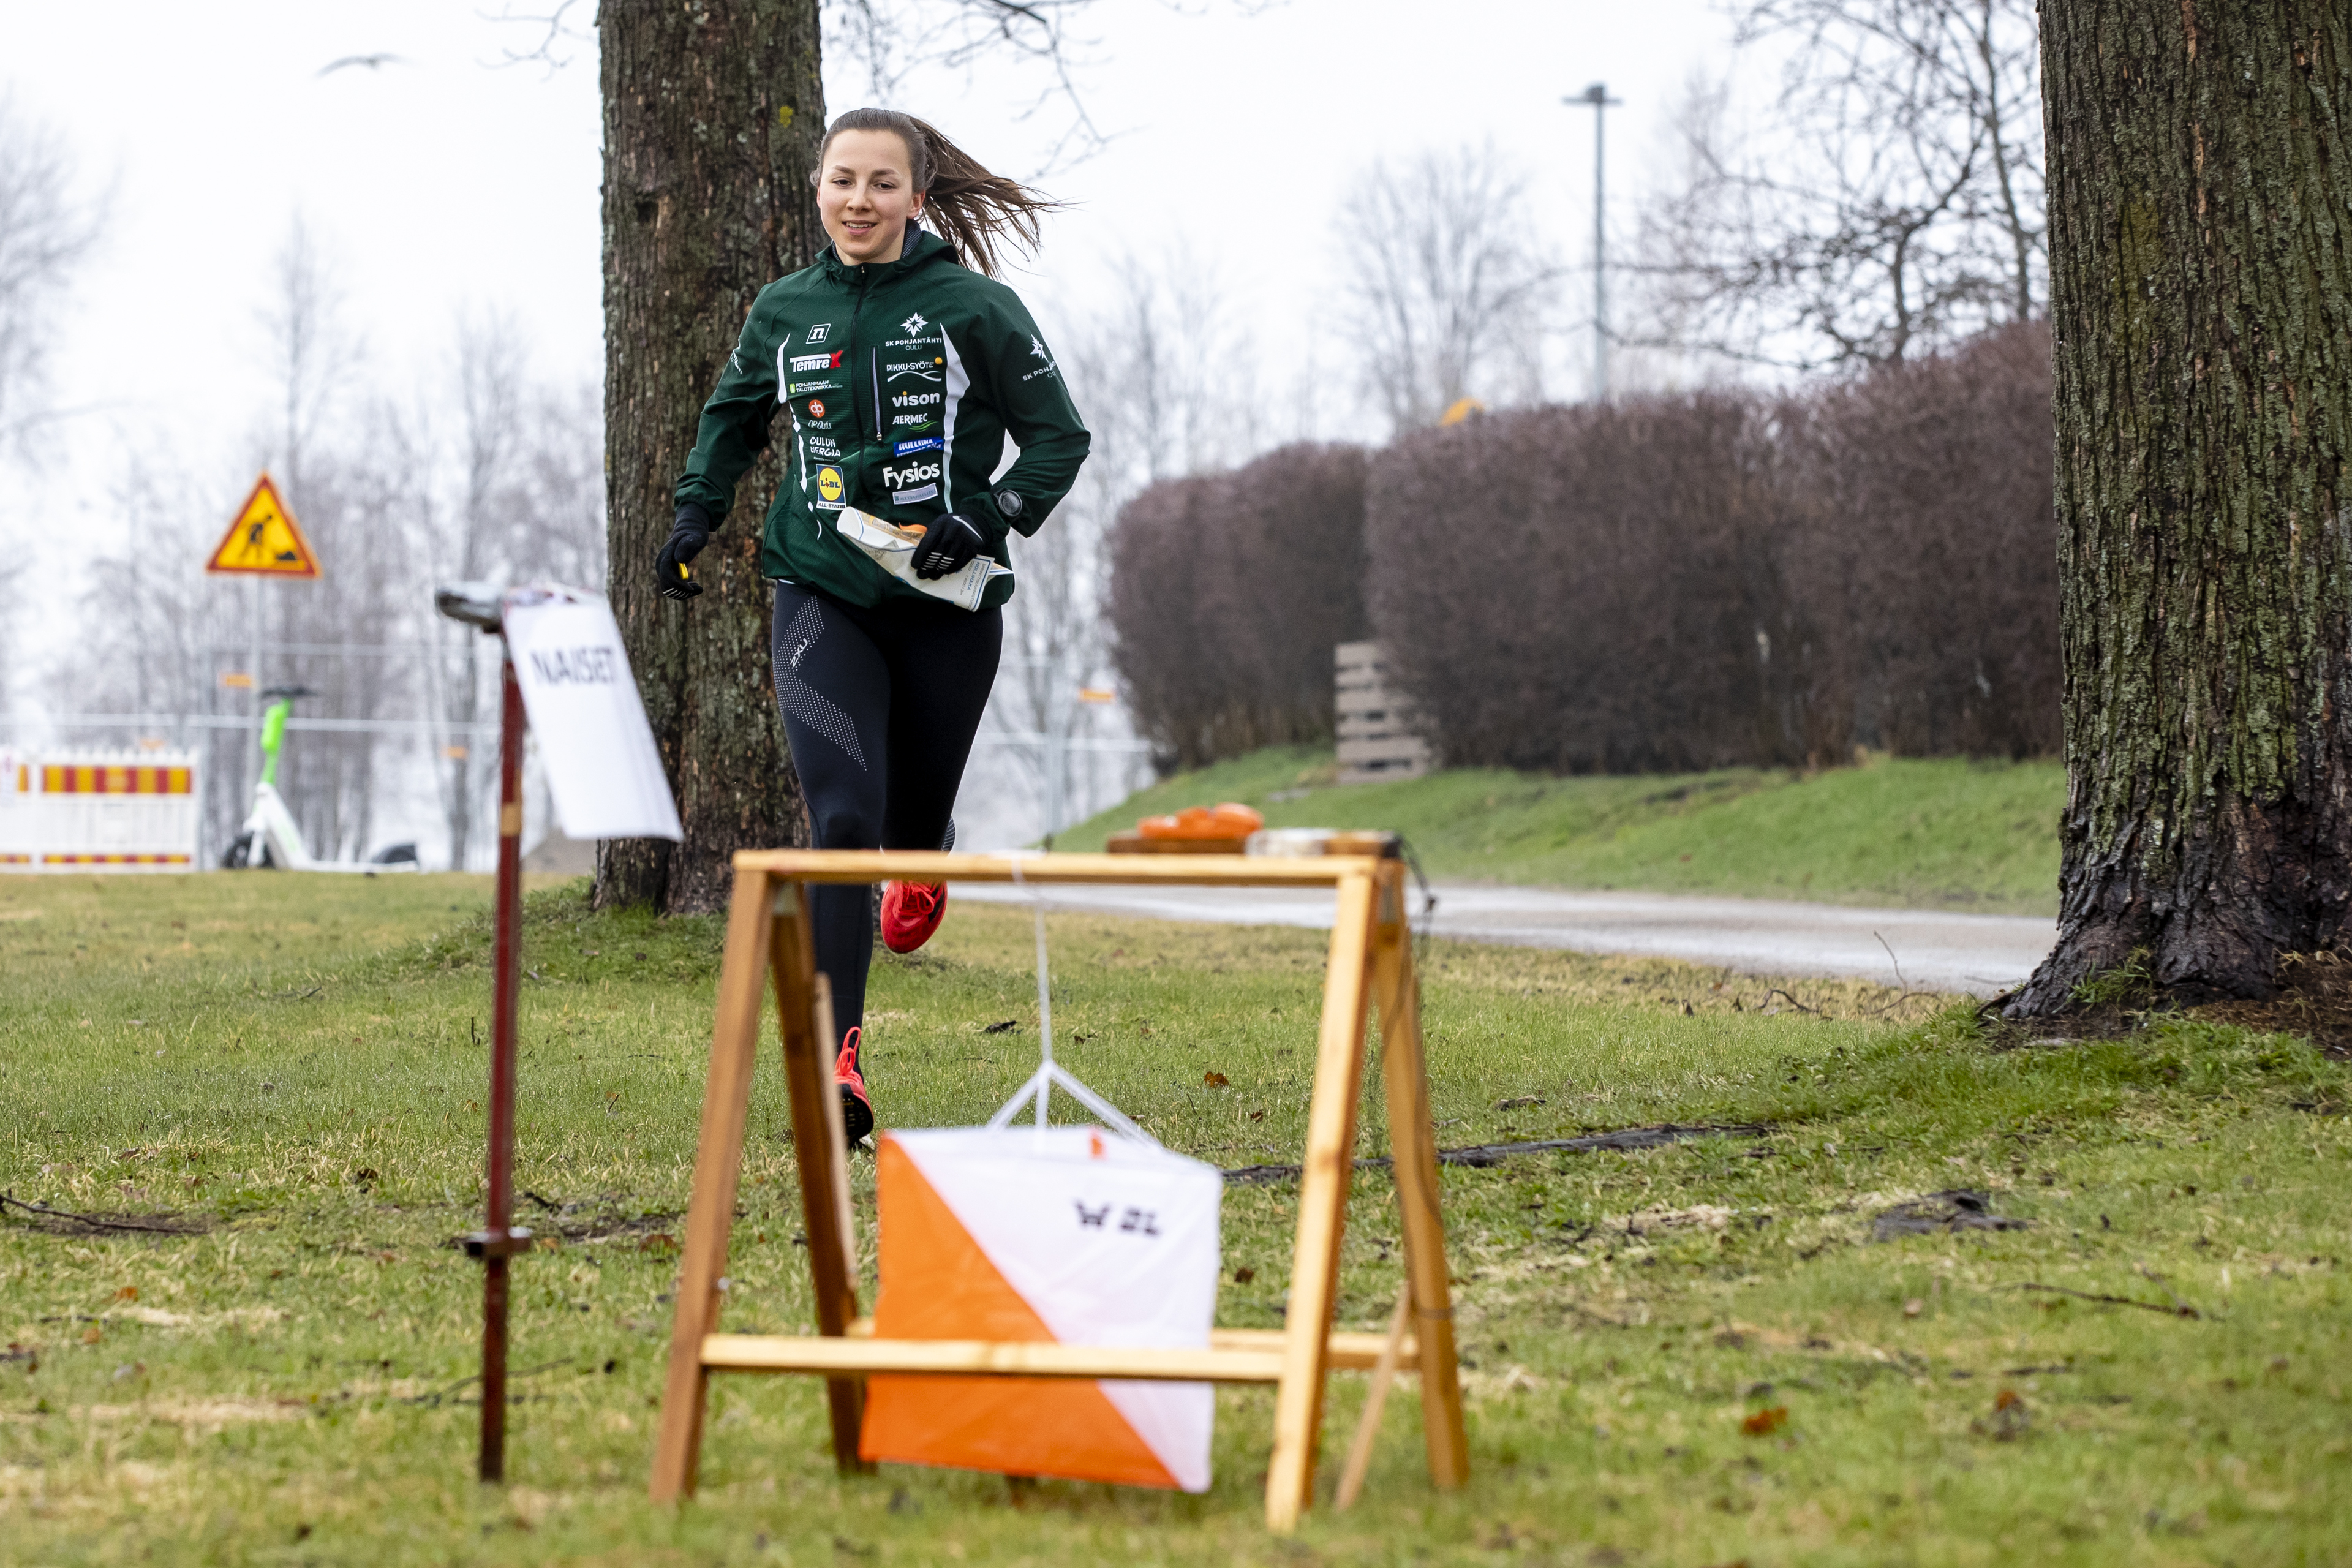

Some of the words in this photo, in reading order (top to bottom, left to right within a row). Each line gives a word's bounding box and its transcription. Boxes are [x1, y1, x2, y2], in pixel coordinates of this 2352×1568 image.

[895, 336, 942, 345] POHJANTÄHTI
[892, 391, 940, 407] vison
[892, 413, 928, 426] AERMEC
[809, 436, 836, 448] OULUN
[883, 461, 940, 489] Fysios
[967, 561, 981, 590] HOLLIHAKA
[790, 638, 809, 668] 2XU
